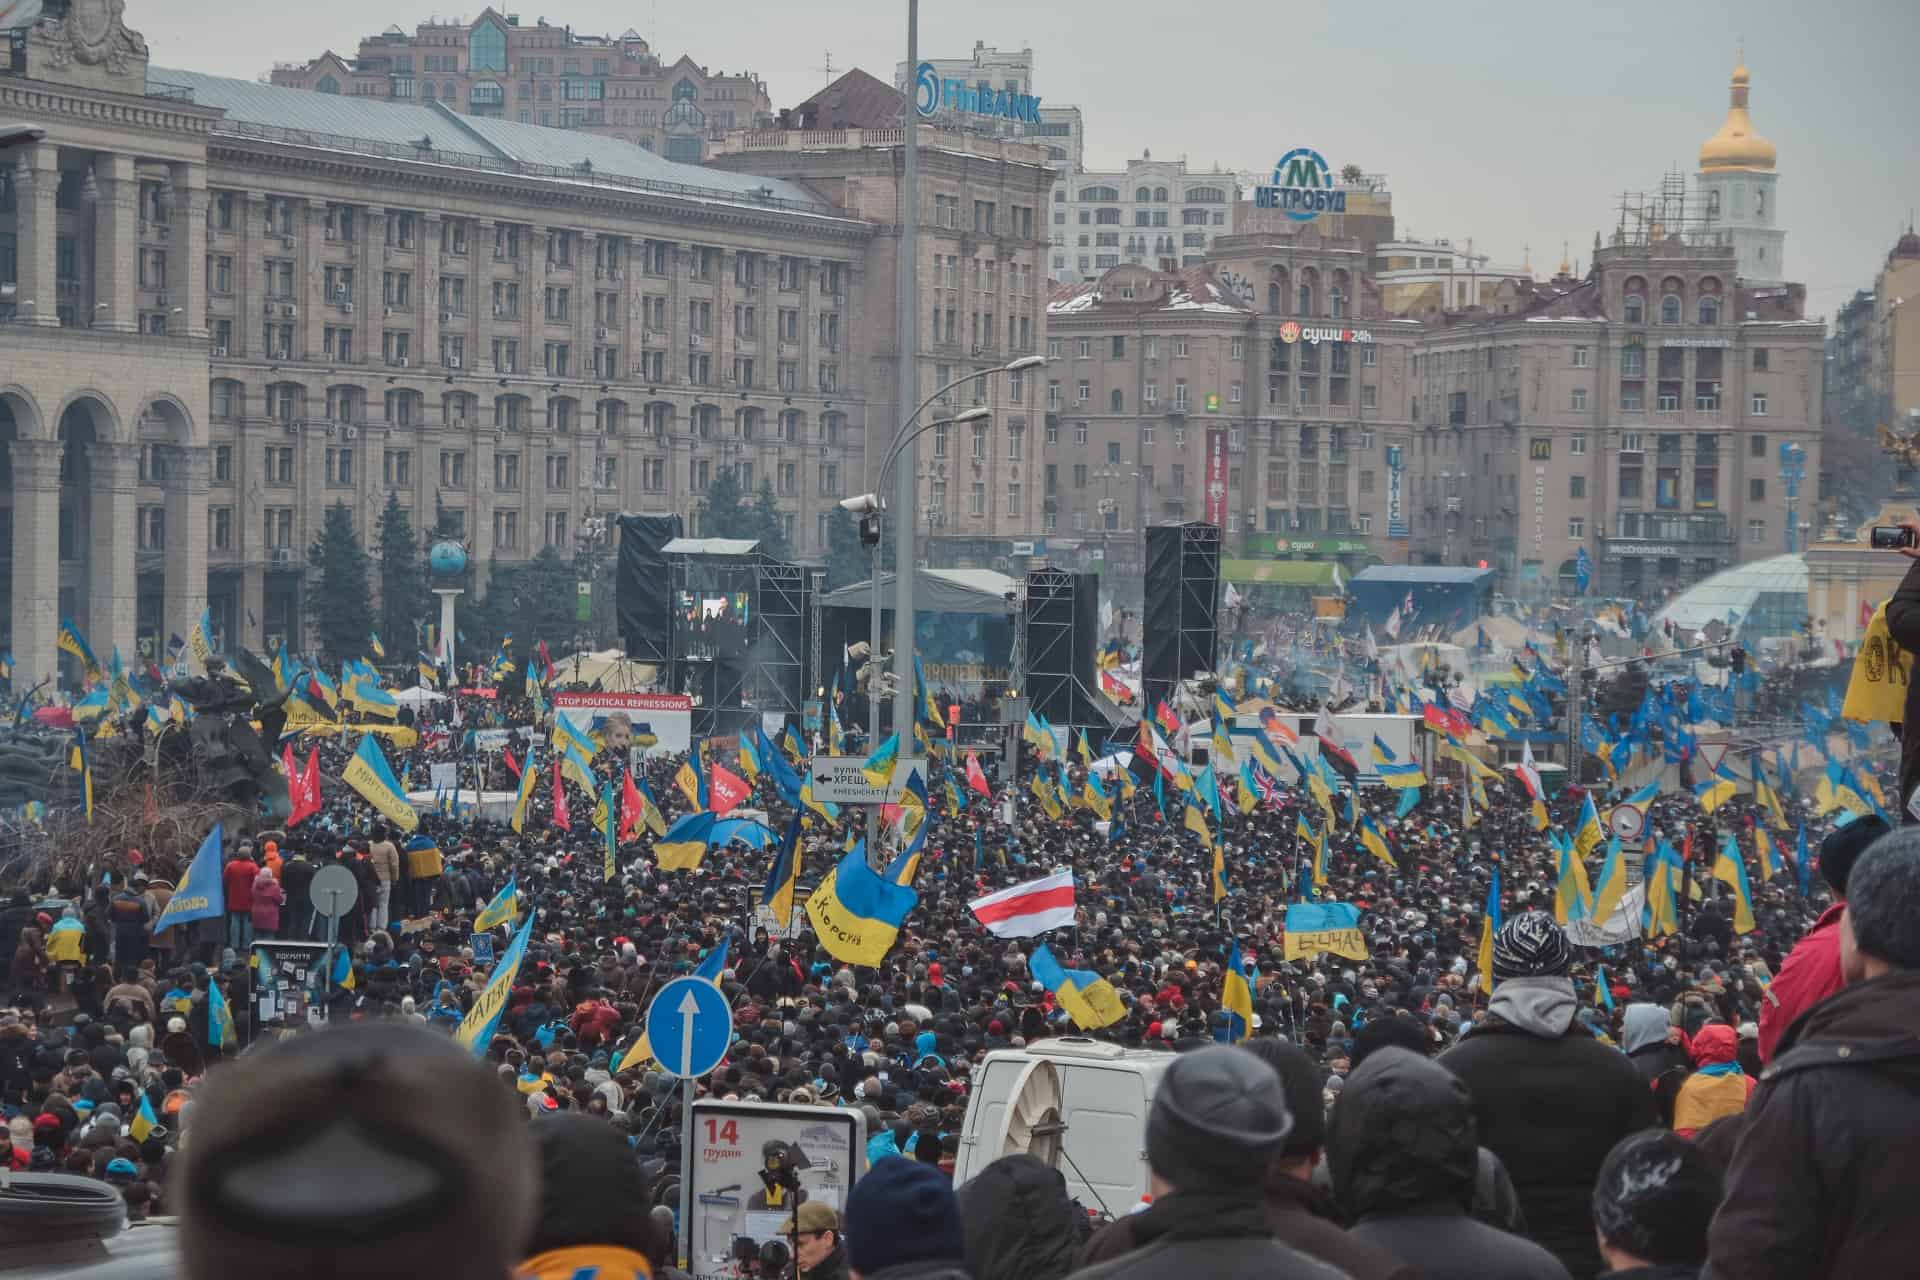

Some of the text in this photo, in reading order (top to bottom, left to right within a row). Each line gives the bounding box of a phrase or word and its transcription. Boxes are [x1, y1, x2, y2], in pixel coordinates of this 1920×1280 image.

[943, 79, 1041, 124] FinBANK
[1256, 186, 1346, 213] МЕТРОБУД
[558, 697, 689, 710] STOP POLITICAL REPRESSIONS
[704, 1119, 738, 1146] 14
[703, 1149, 743, 1162] грудня
